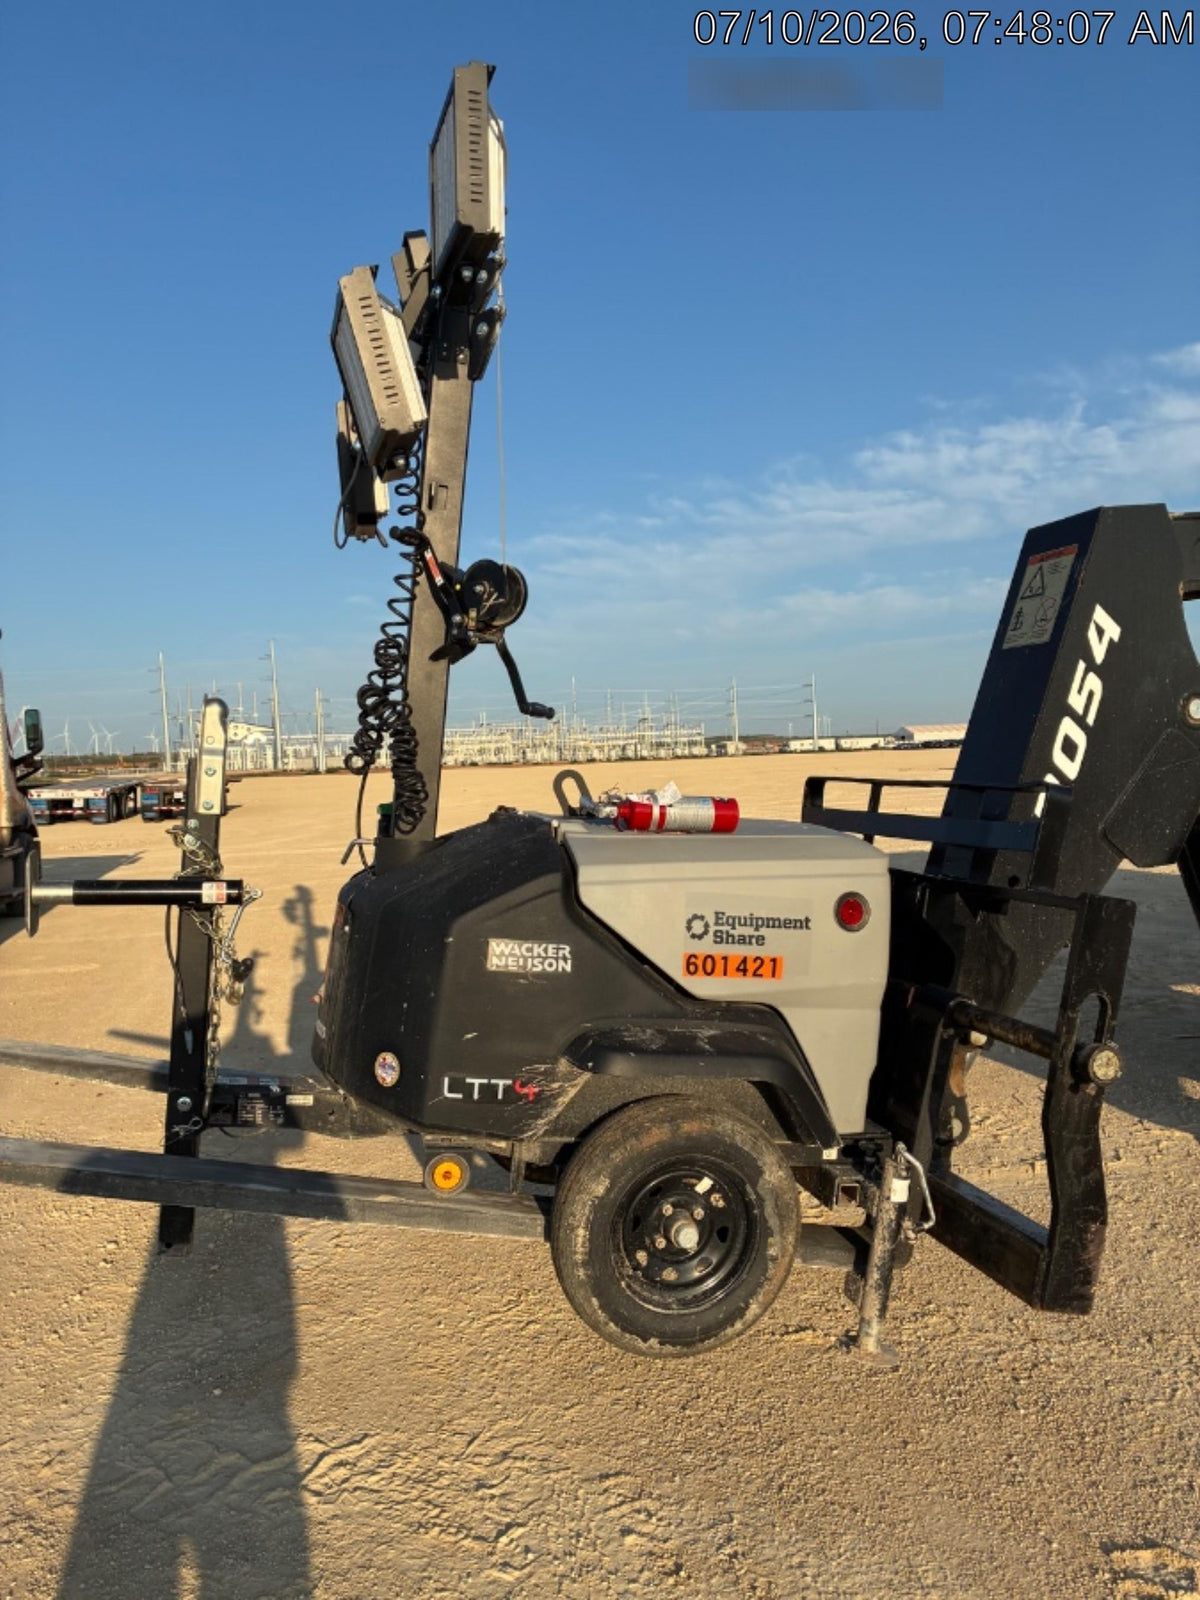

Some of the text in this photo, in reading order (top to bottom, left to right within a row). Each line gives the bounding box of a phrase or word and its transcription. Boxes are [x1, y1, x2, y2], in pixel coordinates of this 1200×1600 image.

[713, 911, 811, 931] Equipment
[713, 930, 765, 946] Share
[490, 942, 571, 958] WACKER
[685, 954, 777, 978] 601421
